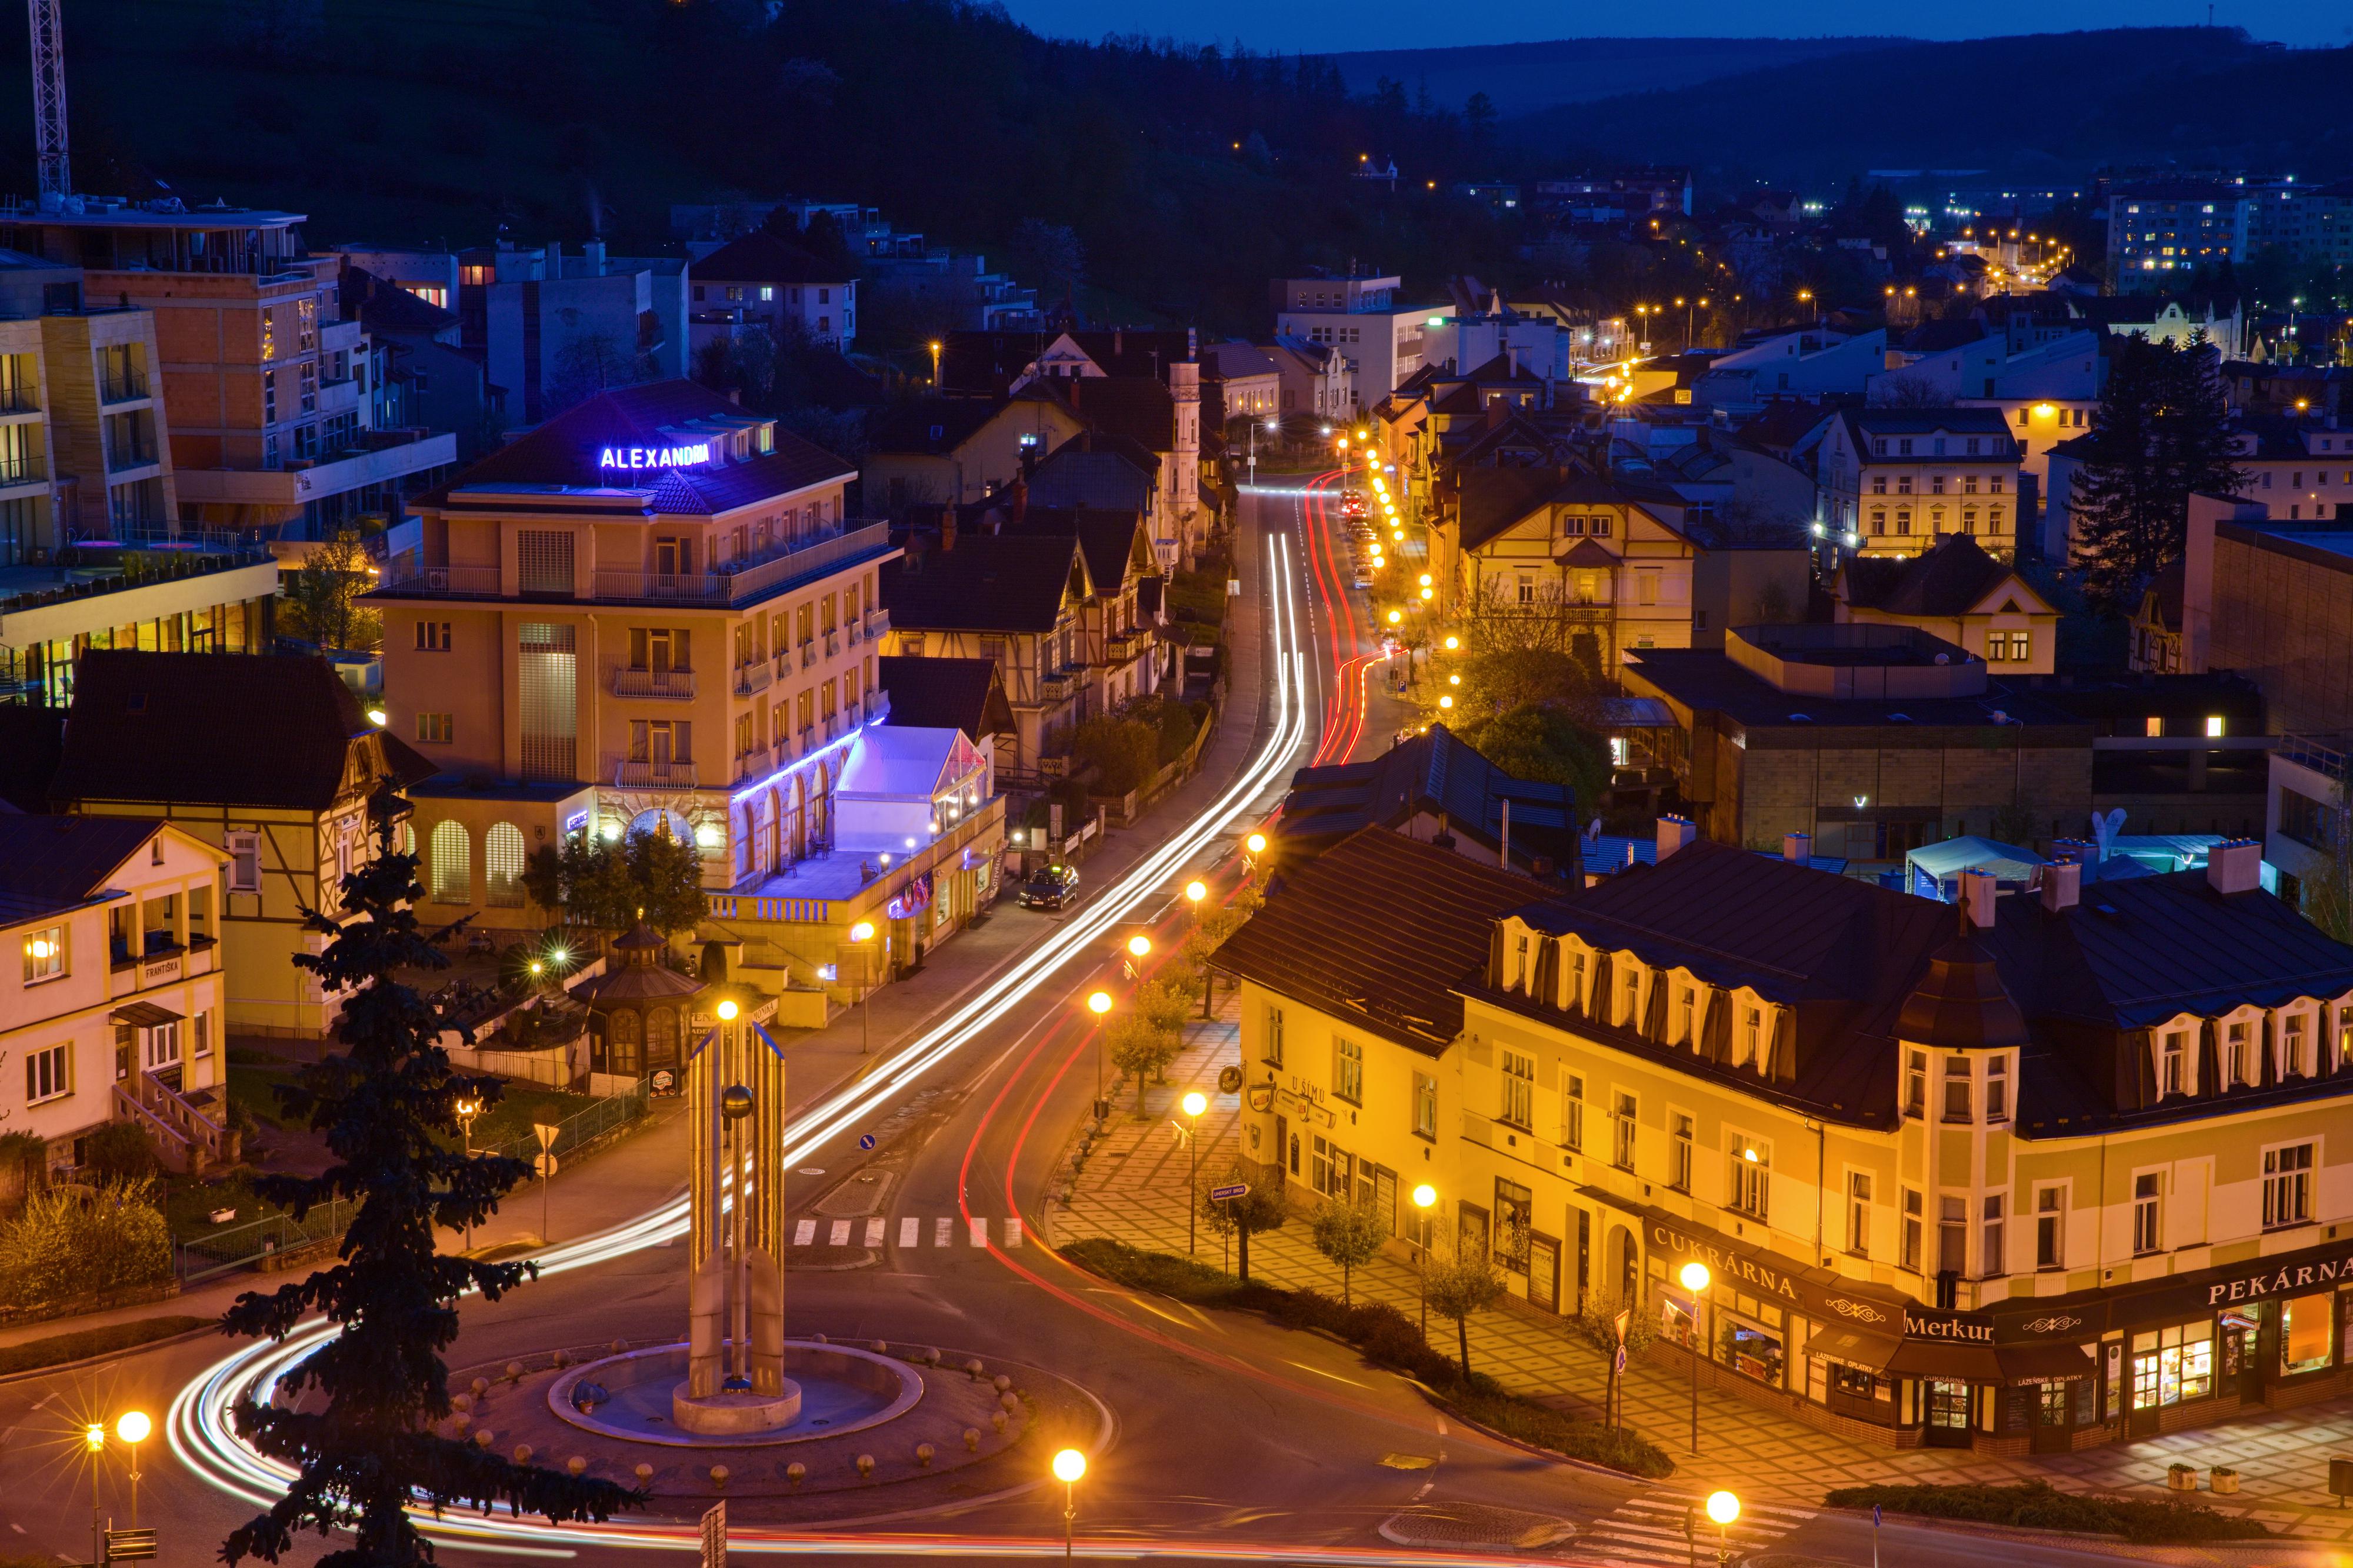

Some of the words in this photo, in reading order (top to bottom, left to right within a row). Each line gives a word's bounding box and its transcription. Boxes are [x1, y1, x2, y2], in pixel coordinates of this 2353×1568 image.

[601, 443, 709, 469] ALEXANDRIA
[146, 961, 178, 979] FRANTIŠKA
[1292, 1076, 1298, 1090] U
[1302, 1078, 1325, 1103] ŠÍMŮ
[1214, 1189, 1232, 1197] UHERSKÝ
[1654, 1227, 1797, 1300] CUKRÁRNA
[2208, 1256, 2353, 1305] PEKÁRNA
[1905, 1317, 1994, 1341] Merkur
[1848, 1360, 1873, 1373] OPLATKY
[1924, 1374, 1966, 1384] CUKRÁRNA
[2054, 1374, 2082, 1383] OPLATKY
